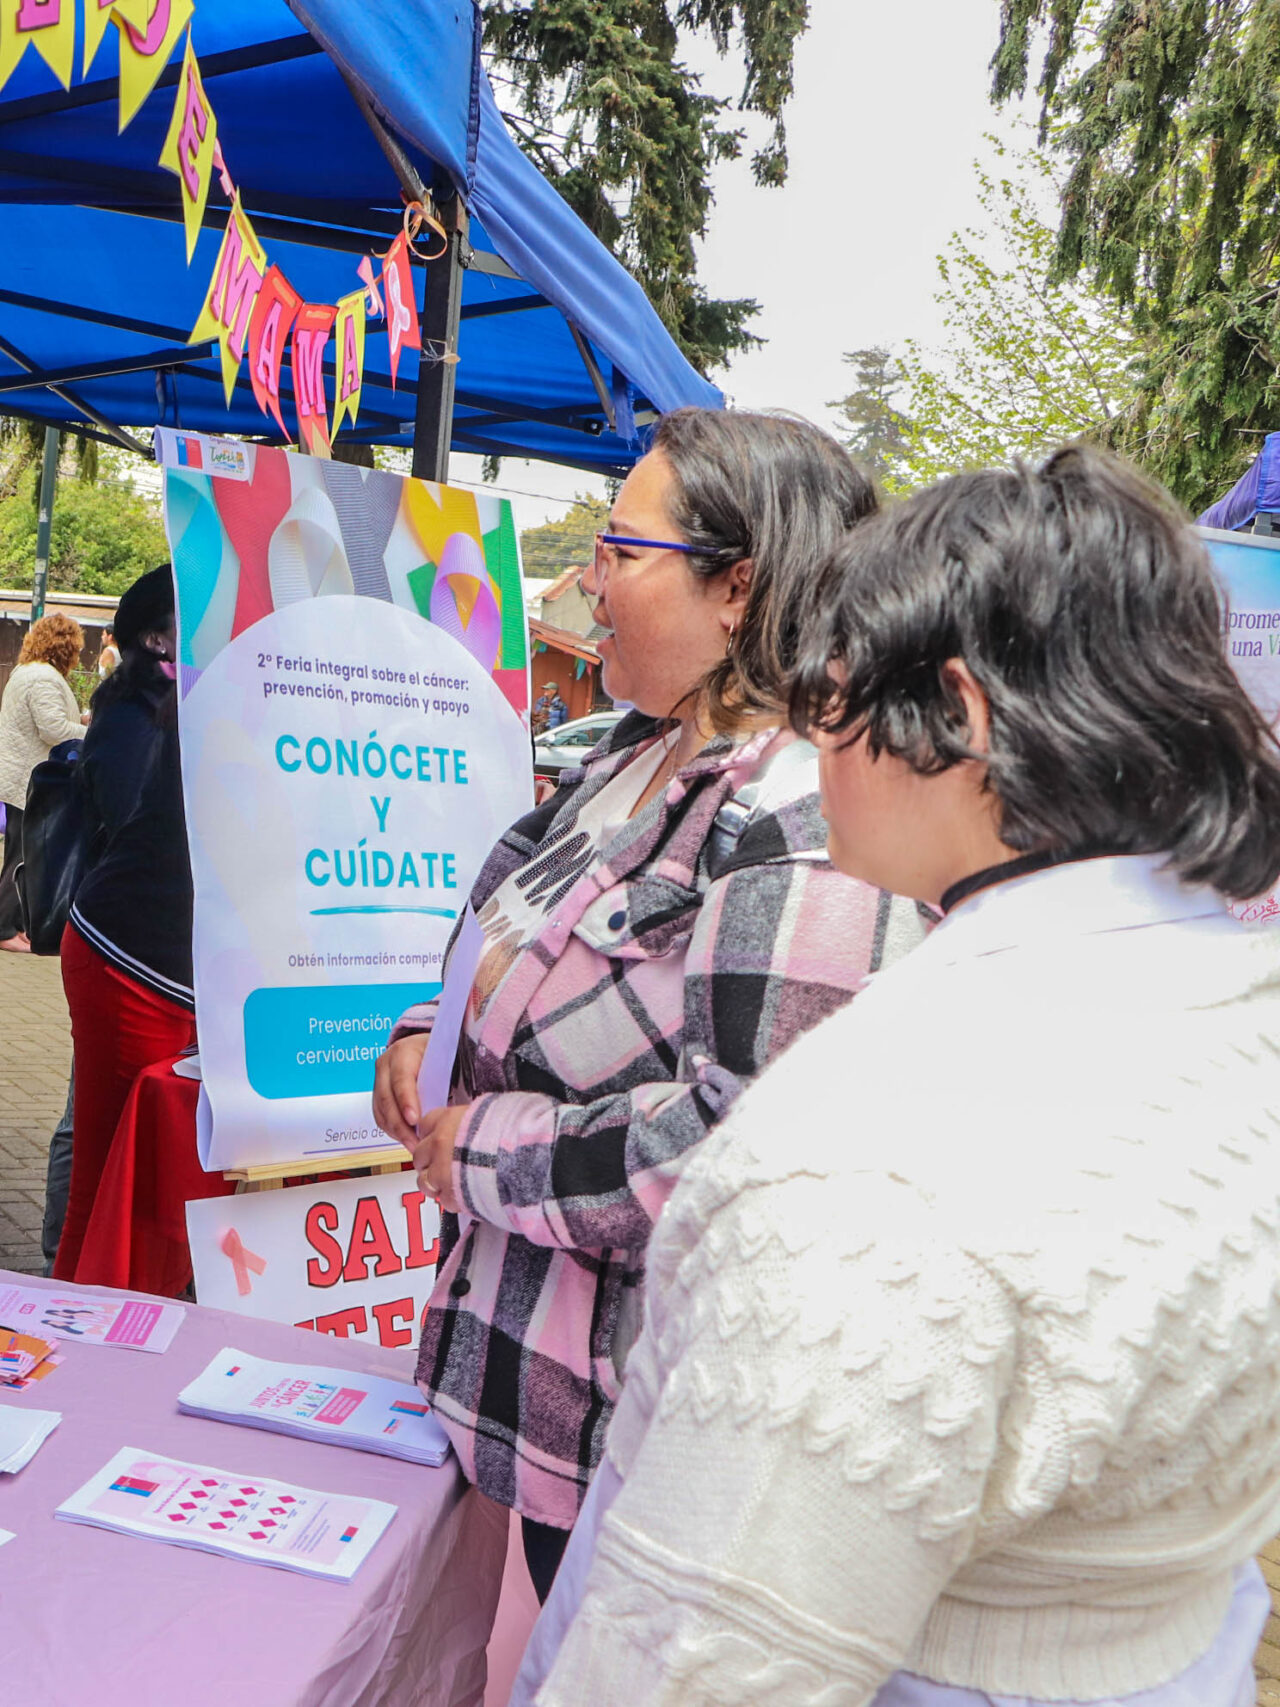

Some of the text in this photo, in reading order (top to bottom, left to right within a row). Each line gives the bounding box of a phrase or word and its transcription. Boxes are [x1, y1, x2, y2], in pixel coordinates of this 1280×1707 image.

[210, 213, 359, 417] MAMA
[1229, 612, 1280, 630] prome
[1232, 640, 1263, 657] una
[276, 656, 312, 673] Feria
[315, 658, 369, 682] integral
[372, 667, 406, 684] sobre
[409, 671, 420, 686] el
[423, 672, 469, 691] cáncer:
[263, 681, 470, 717] prevención, promoción y apoyo
[275, 729, 469, 785] CONÓCETE
[370, 795, 391, 833] Y
[305, 837, 457, 889] CUÍDATE
[288, 952, 444, 968] Obtén información complet
[309, 1013, 393, 1034] Prevención
[324, 1127, 385, 1143] Servicio de
[305, 1190, 444, 1289] SAL
